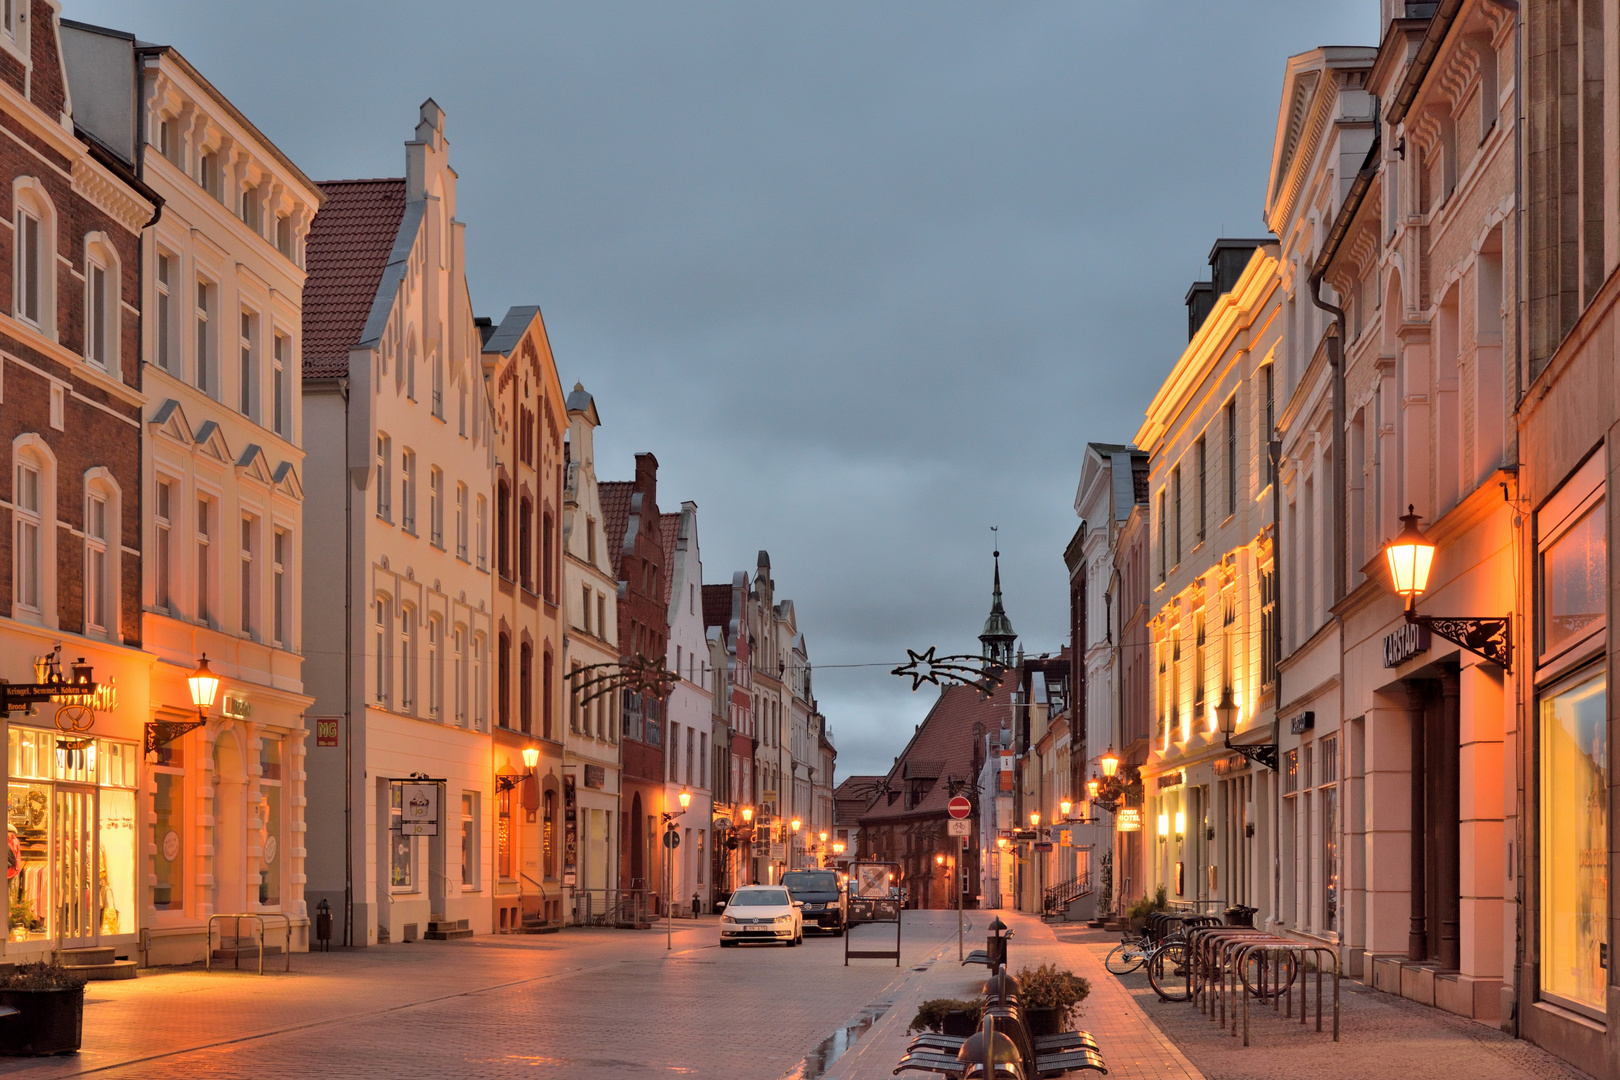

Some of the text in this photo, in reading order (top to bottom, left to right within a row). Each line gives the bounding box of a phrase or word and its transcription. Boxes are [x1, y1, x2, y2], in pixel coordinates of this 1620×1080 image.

[1383, 623, 1419, 668] KARSTADT
[7, 687, 31, 696] Kringel,
[33, 687, 59, 695] Semmel,
[61, 686, 80, 694] Koken
[318, 722, 337, 738] MG
[415, 808, 423, 816] jo
[413, 825, 423, 834] jo
